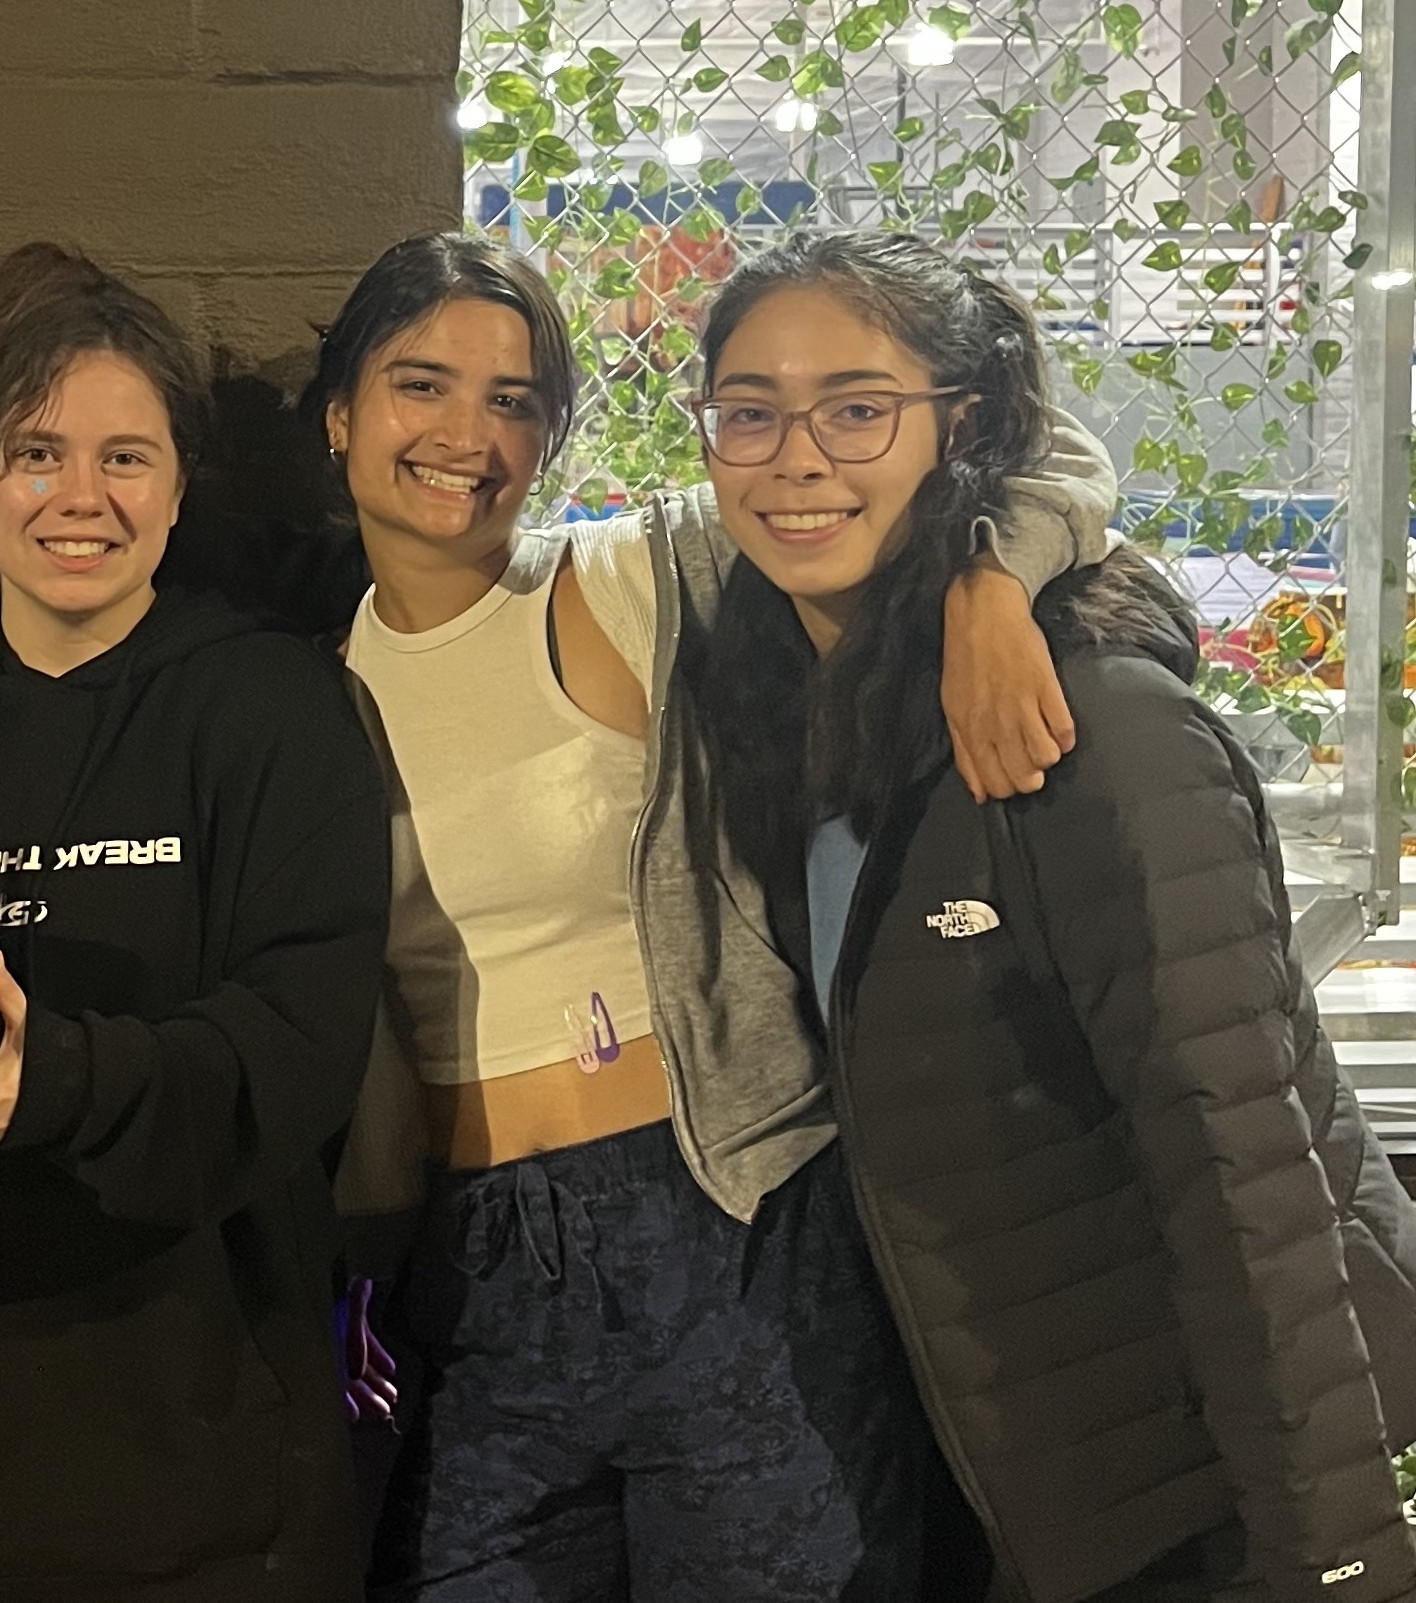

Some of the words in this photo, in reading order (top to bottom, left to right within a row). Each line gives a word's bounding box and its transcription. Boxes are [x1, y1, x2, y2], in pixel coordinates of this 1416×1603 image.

[53, 837, 181, 870] BREAK
[943, 901, 967, 913] THE
[926, 914, 969, 928] NORTH
[940, 925, 975, 938] FACE
[1321, 1560, 1364, 1584] 600
